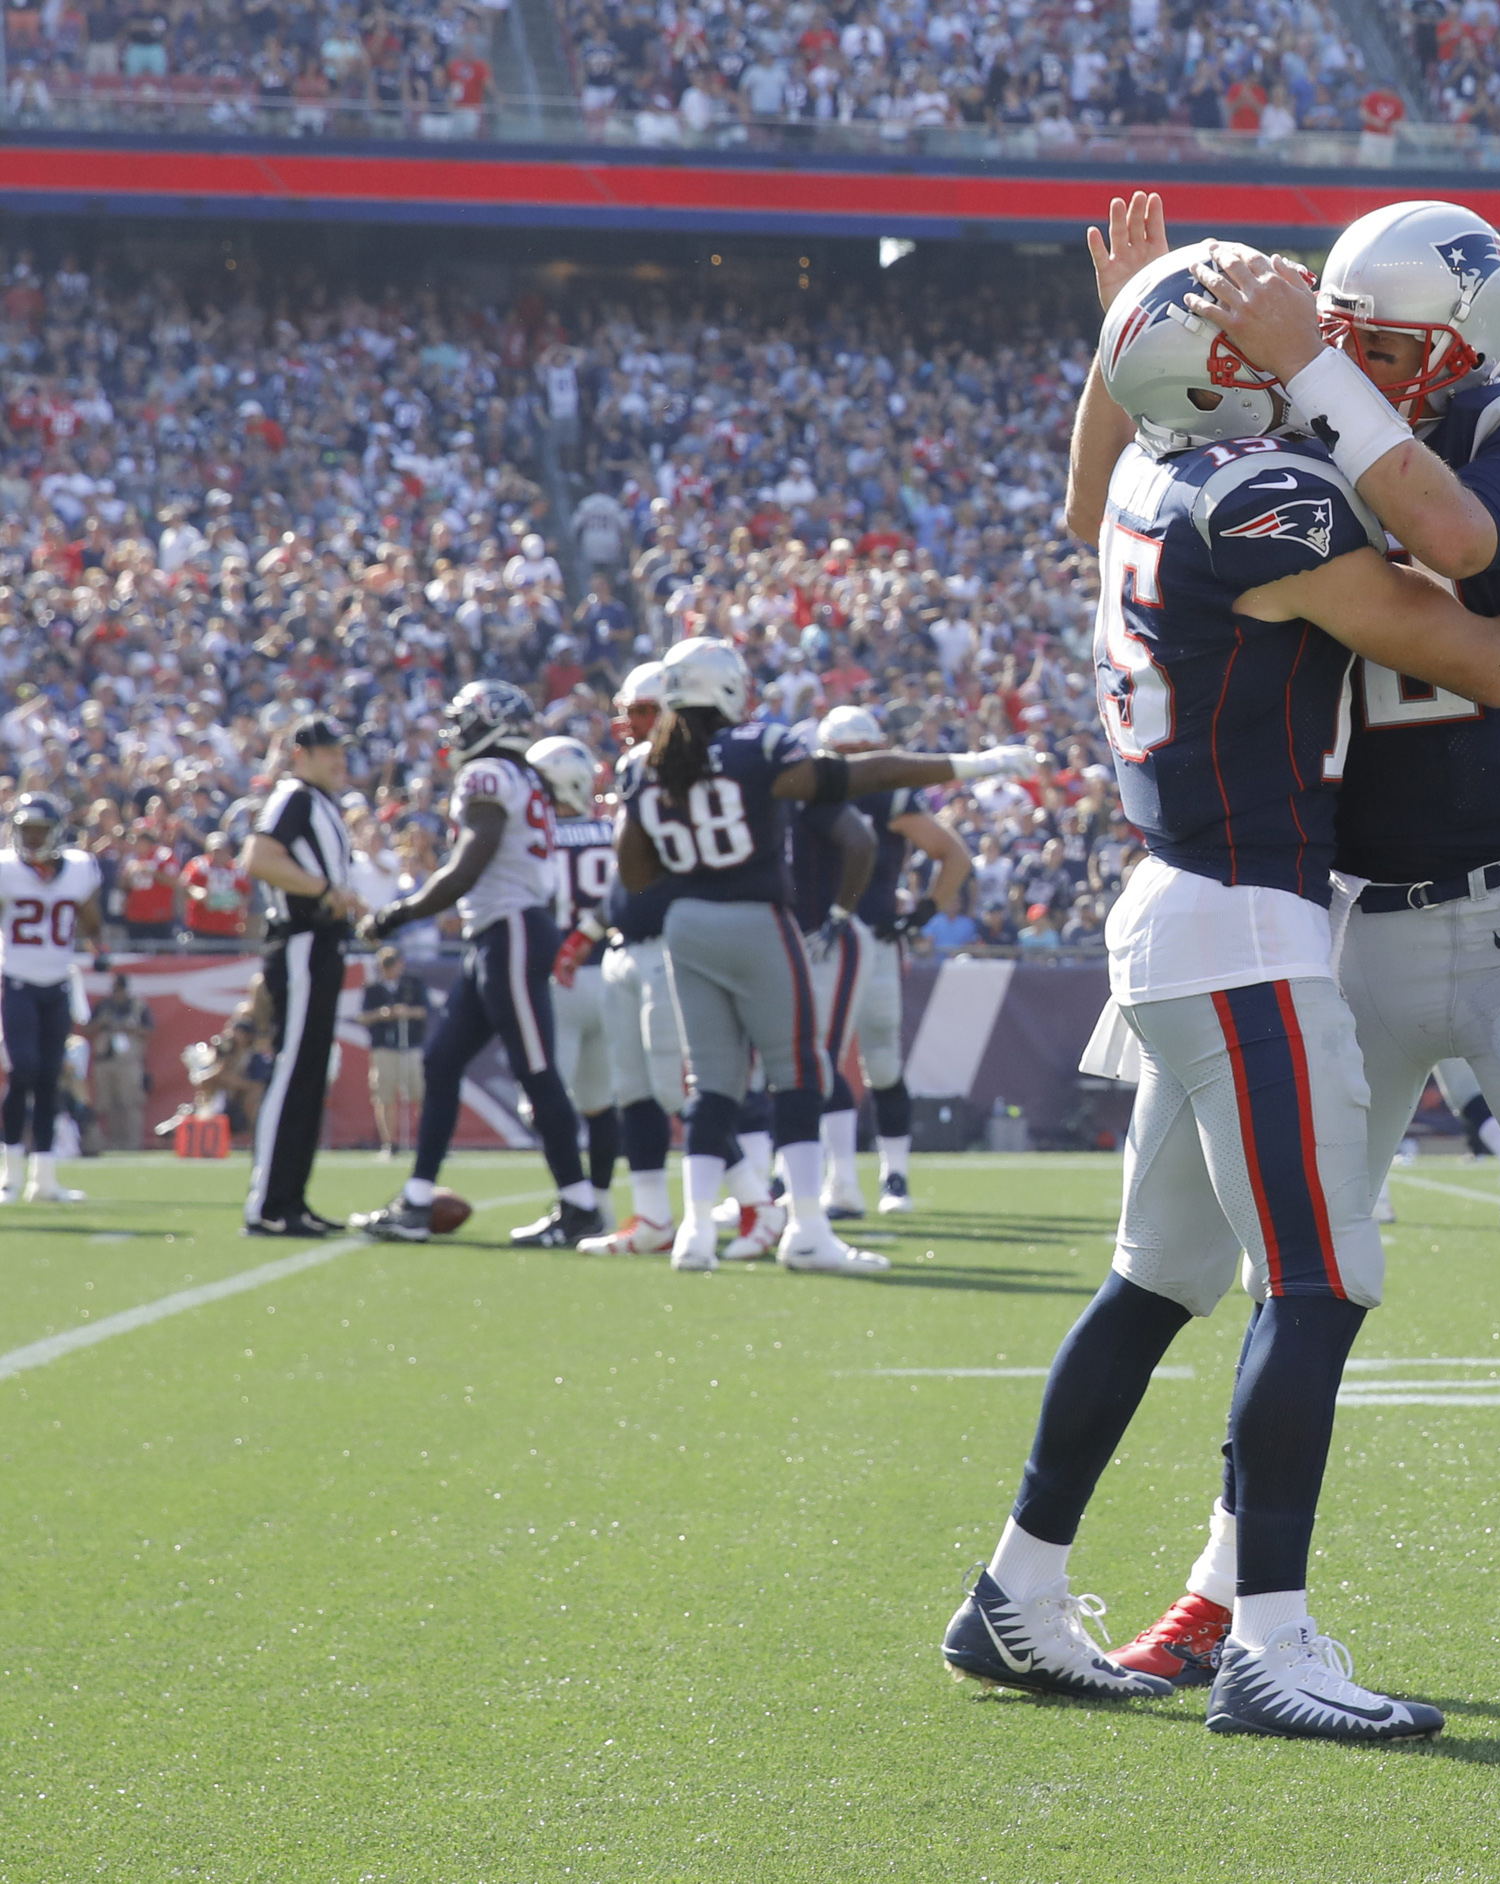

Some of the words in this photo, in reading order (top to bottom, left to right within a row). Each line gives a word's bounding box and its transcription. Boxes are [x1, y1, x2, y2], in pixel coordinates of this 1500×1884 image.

[1203, 434, 1282, 469] 15
[639, 776, 755, 874] 68
[12, 898, 79, 947] 20
